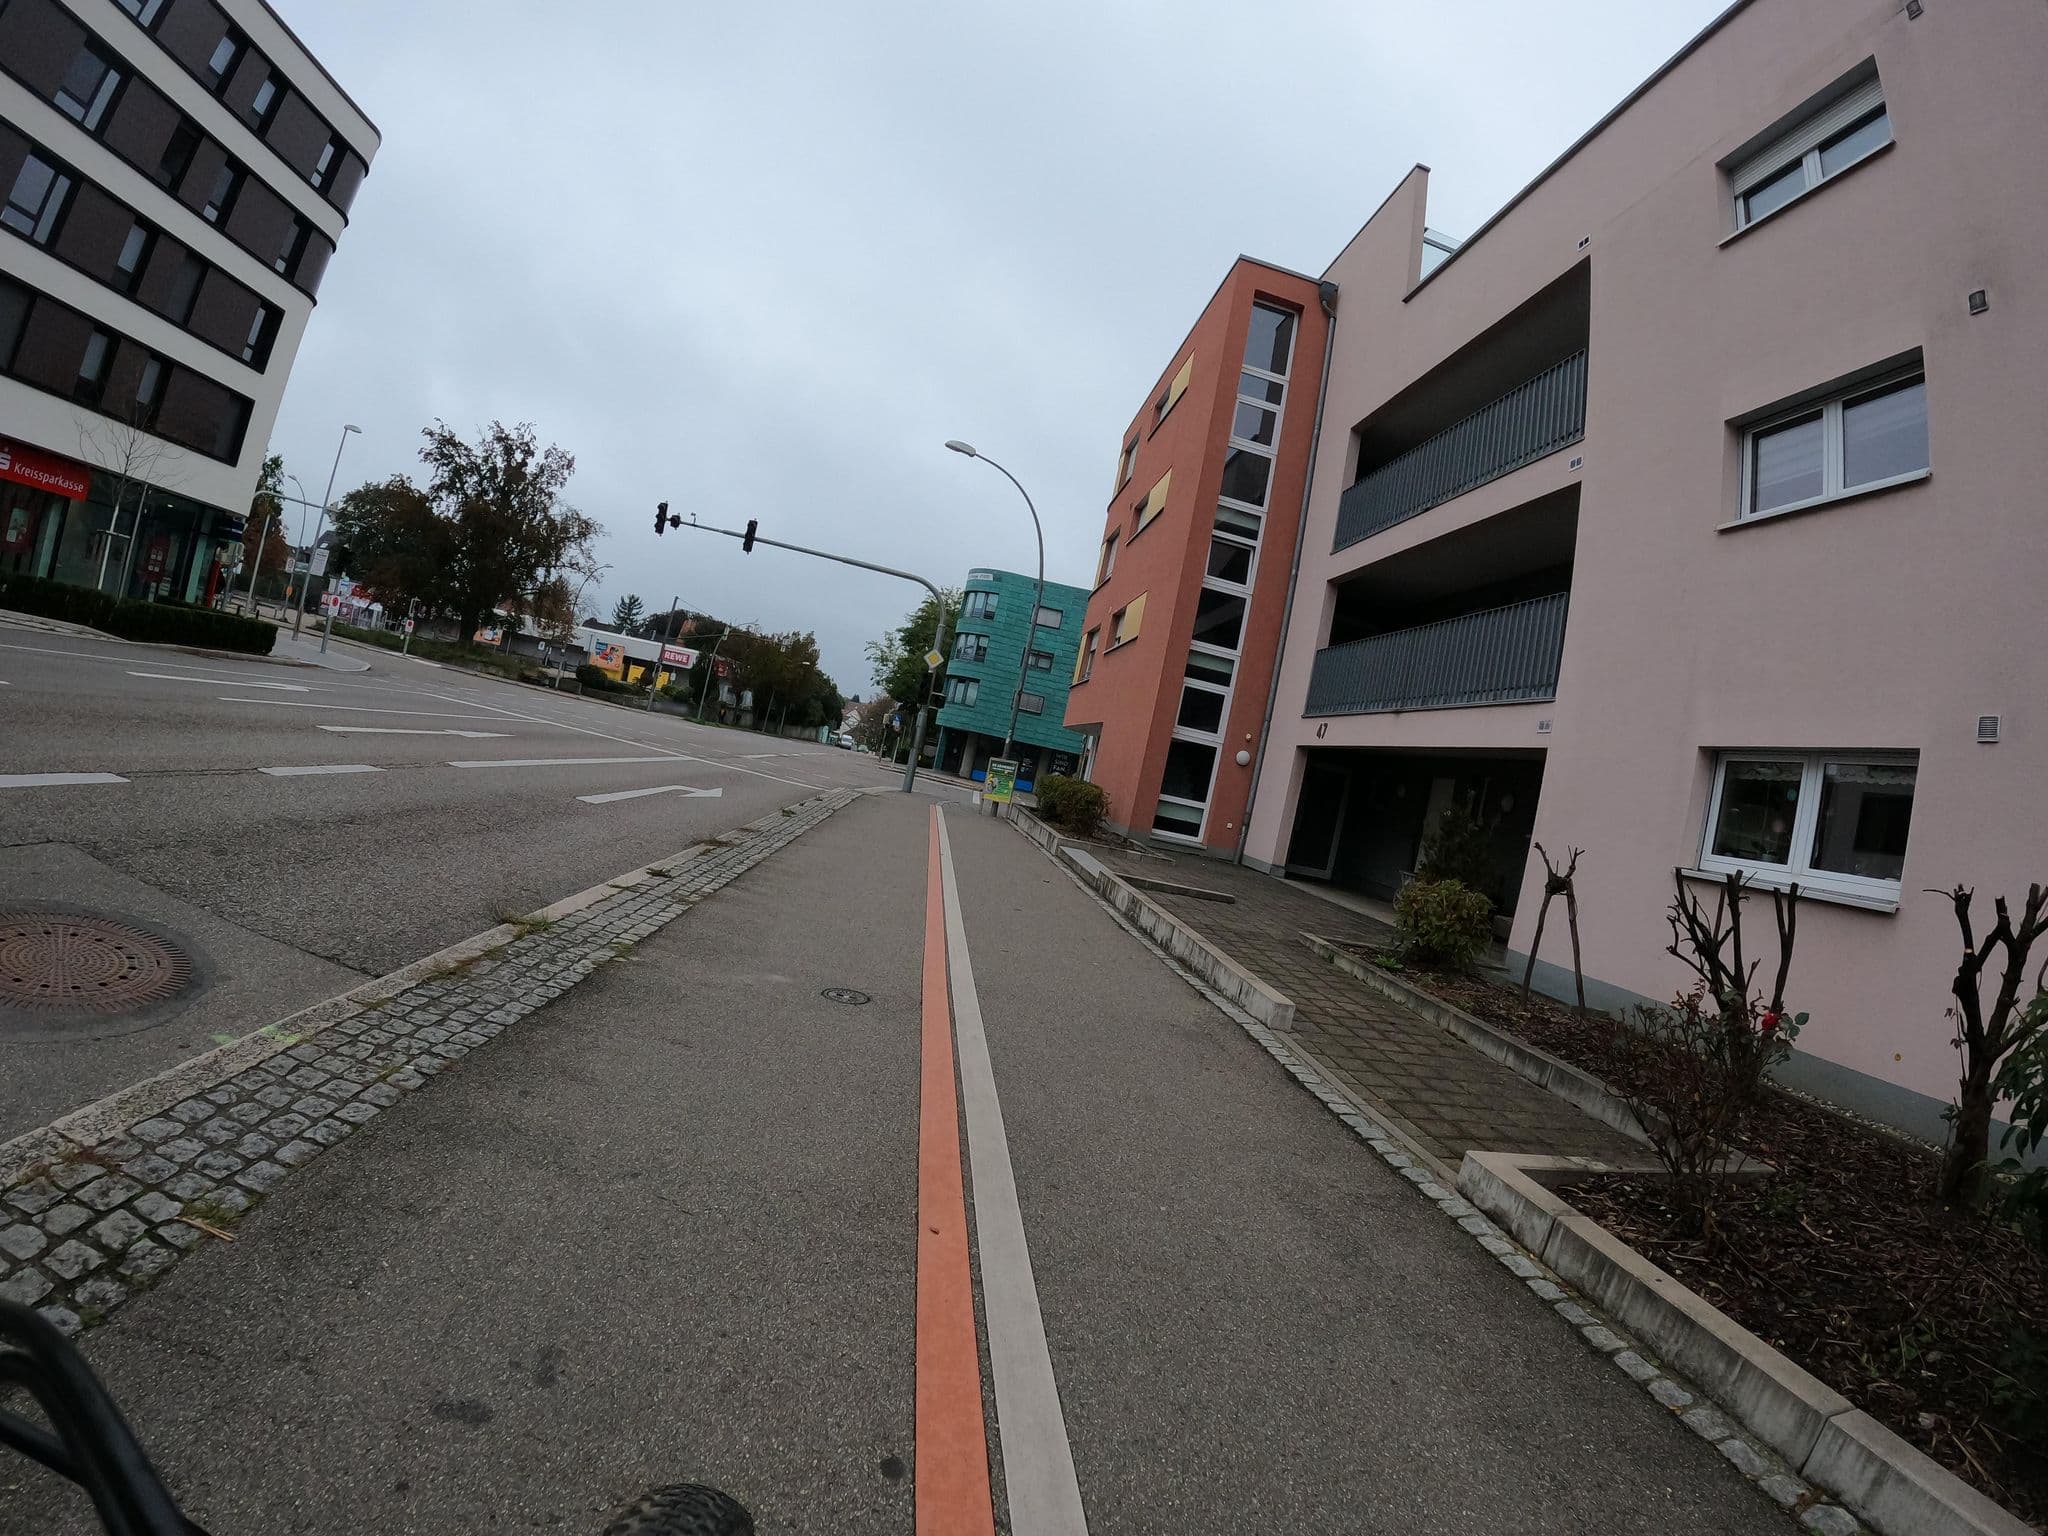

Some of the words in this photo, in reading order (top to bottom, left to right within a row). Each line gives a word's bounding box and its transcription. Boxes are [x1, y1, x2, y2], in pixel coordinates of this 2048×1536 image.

[13, 462, 84, 492] Kreissparkasse
[663, 651, 689, 663] REWE
[1316, 722, 1328, 739] 47
